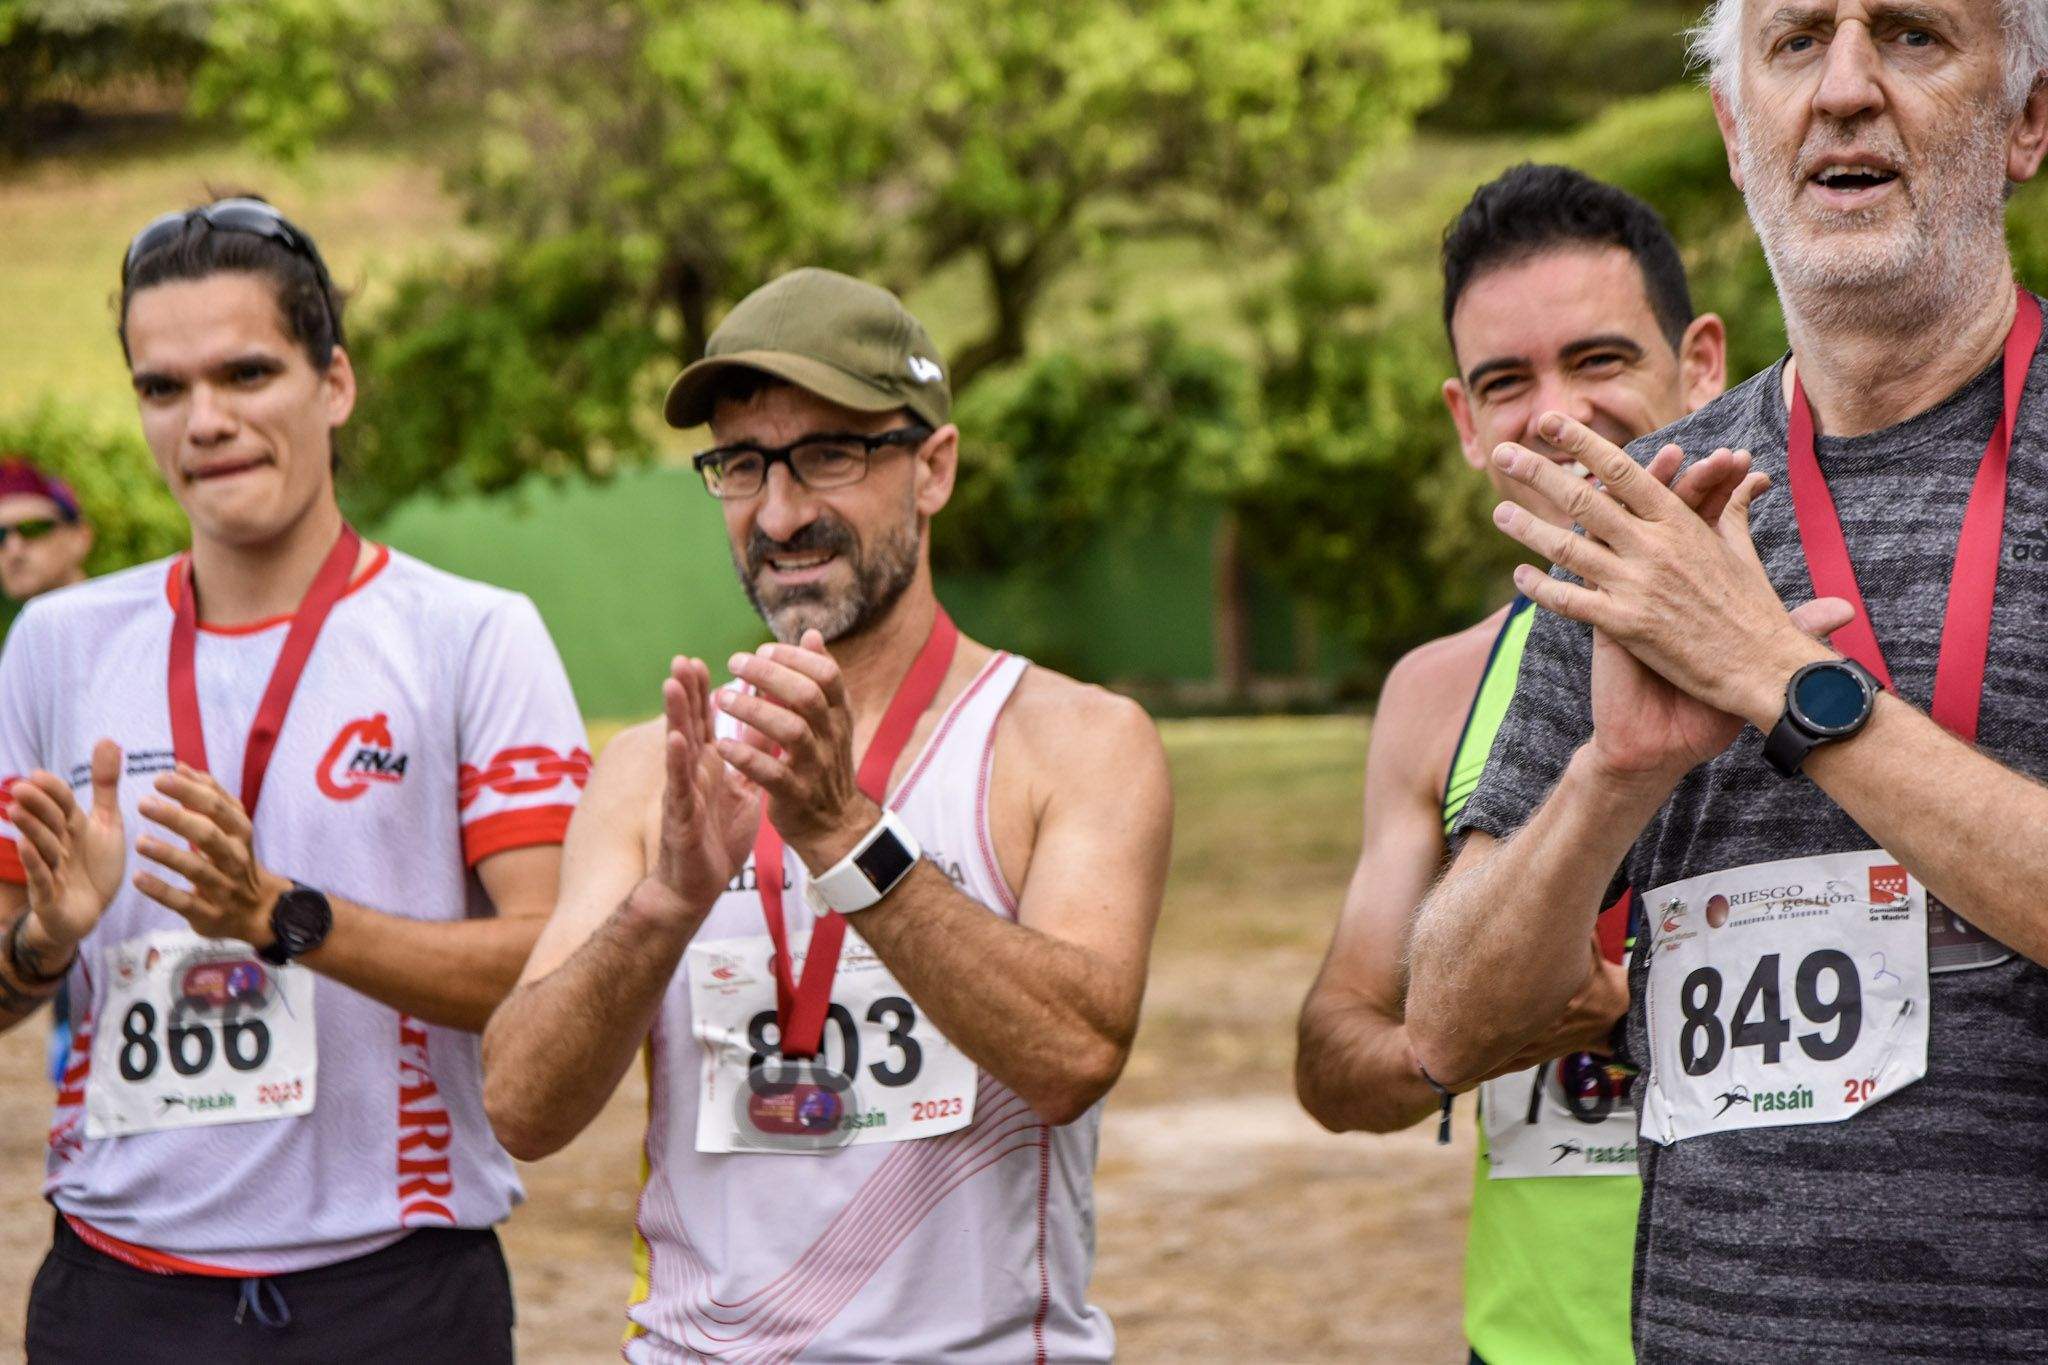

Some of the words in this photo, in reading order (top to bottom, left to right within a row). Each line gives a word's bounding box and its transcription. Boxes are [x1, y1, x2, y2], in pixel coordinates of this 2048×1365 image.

[1729, 885, 1803, 907] RIESGO
[1764, 901, 1779, 914] y
[1782, 891, 1855, 912] gestión
[1680, 949, 1862, 1077] 849
[120, 992, 270, 1081] 866
[747, 996, 922, 1097] 803
[258, 1079, 303, 1105] 2023
[1753, 1084, 1813, 1112] rasán
[841, 1106, 888, 1131] asán
[911, 1096, 964, 1122] 2023
